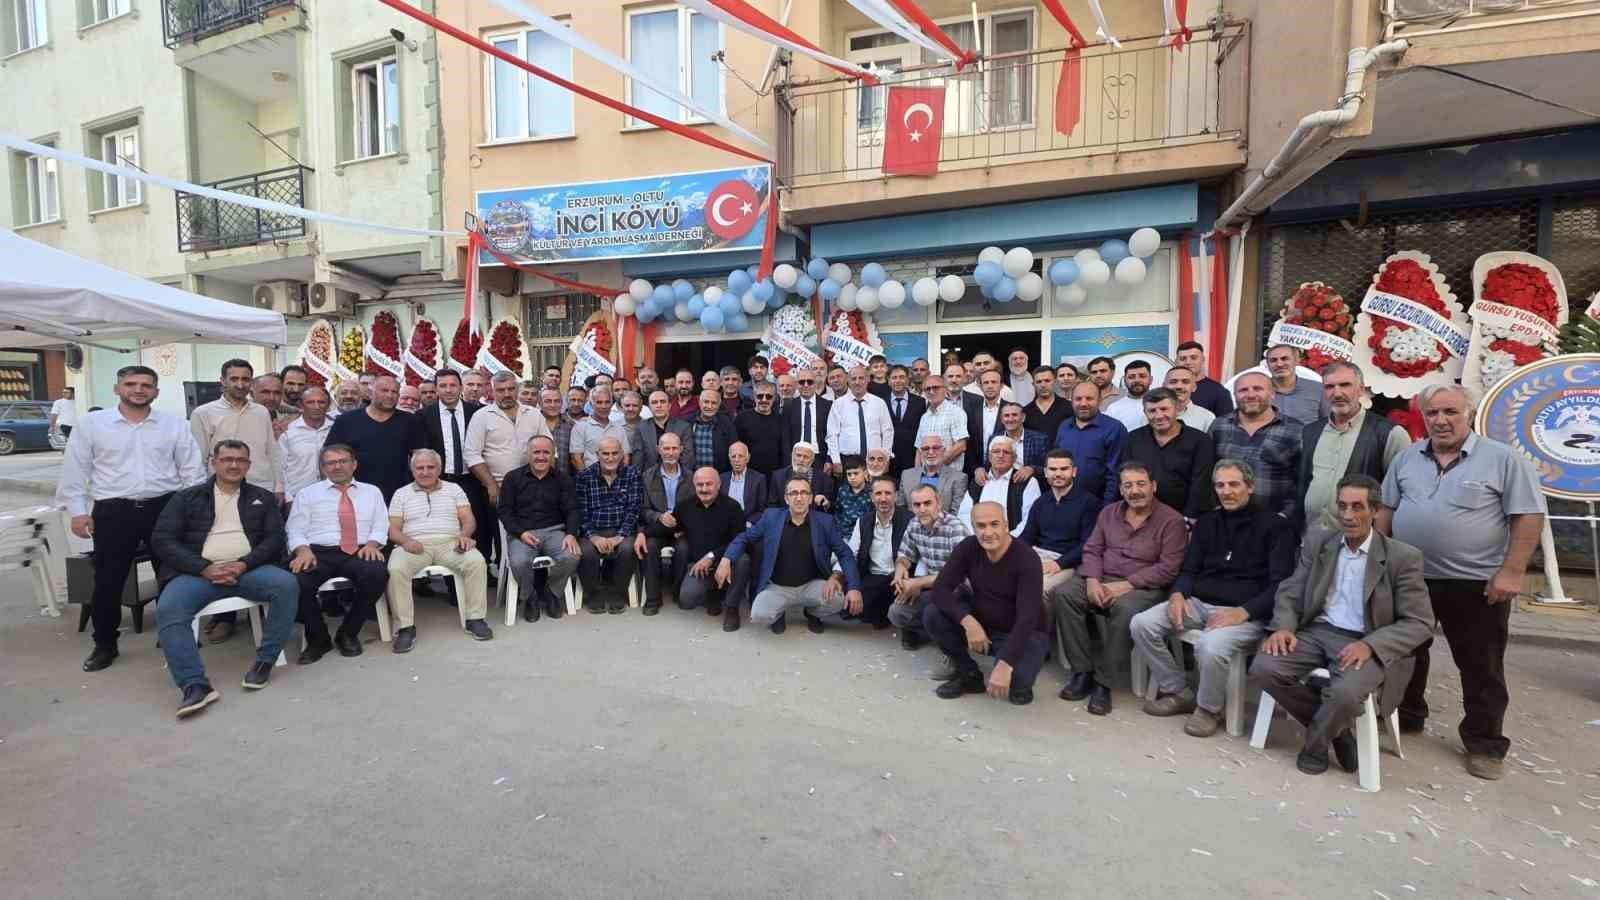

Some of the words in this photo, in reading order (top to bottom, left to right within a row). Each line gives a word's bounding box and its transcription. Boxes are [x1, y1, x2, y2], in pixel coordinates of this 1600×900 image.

[567, 195, 623, 208] ERZURUM
[633, 191, 664, 203] OLTU
[556, 207, 605, 235] İNCİ
[612, 201, 679, 231] KÖYÜ
[569, 238, 583, 248] VE
[1280, 335, 1311, 346] YAKUP
